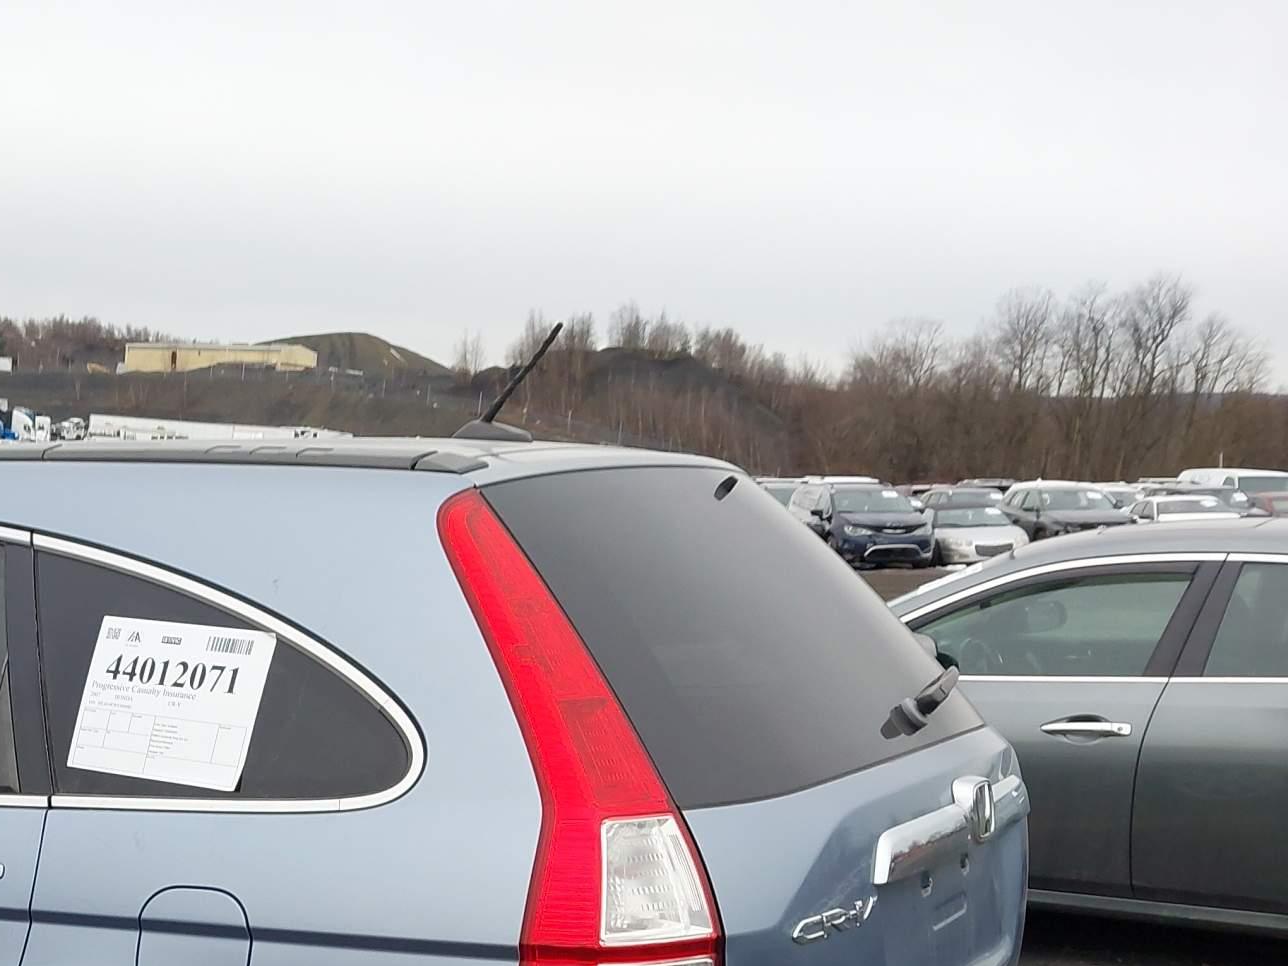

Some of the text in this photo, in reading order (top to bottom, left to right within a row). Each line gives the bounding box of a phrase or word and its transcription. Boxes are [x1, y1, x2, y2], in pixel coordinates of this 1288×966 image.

[91, 680, 130, 693] Progressive
[162, 689, 197, 701] Insurance
[105, 653, 240, 695] 44012071
[792, 896, 878, 942] CR-V
